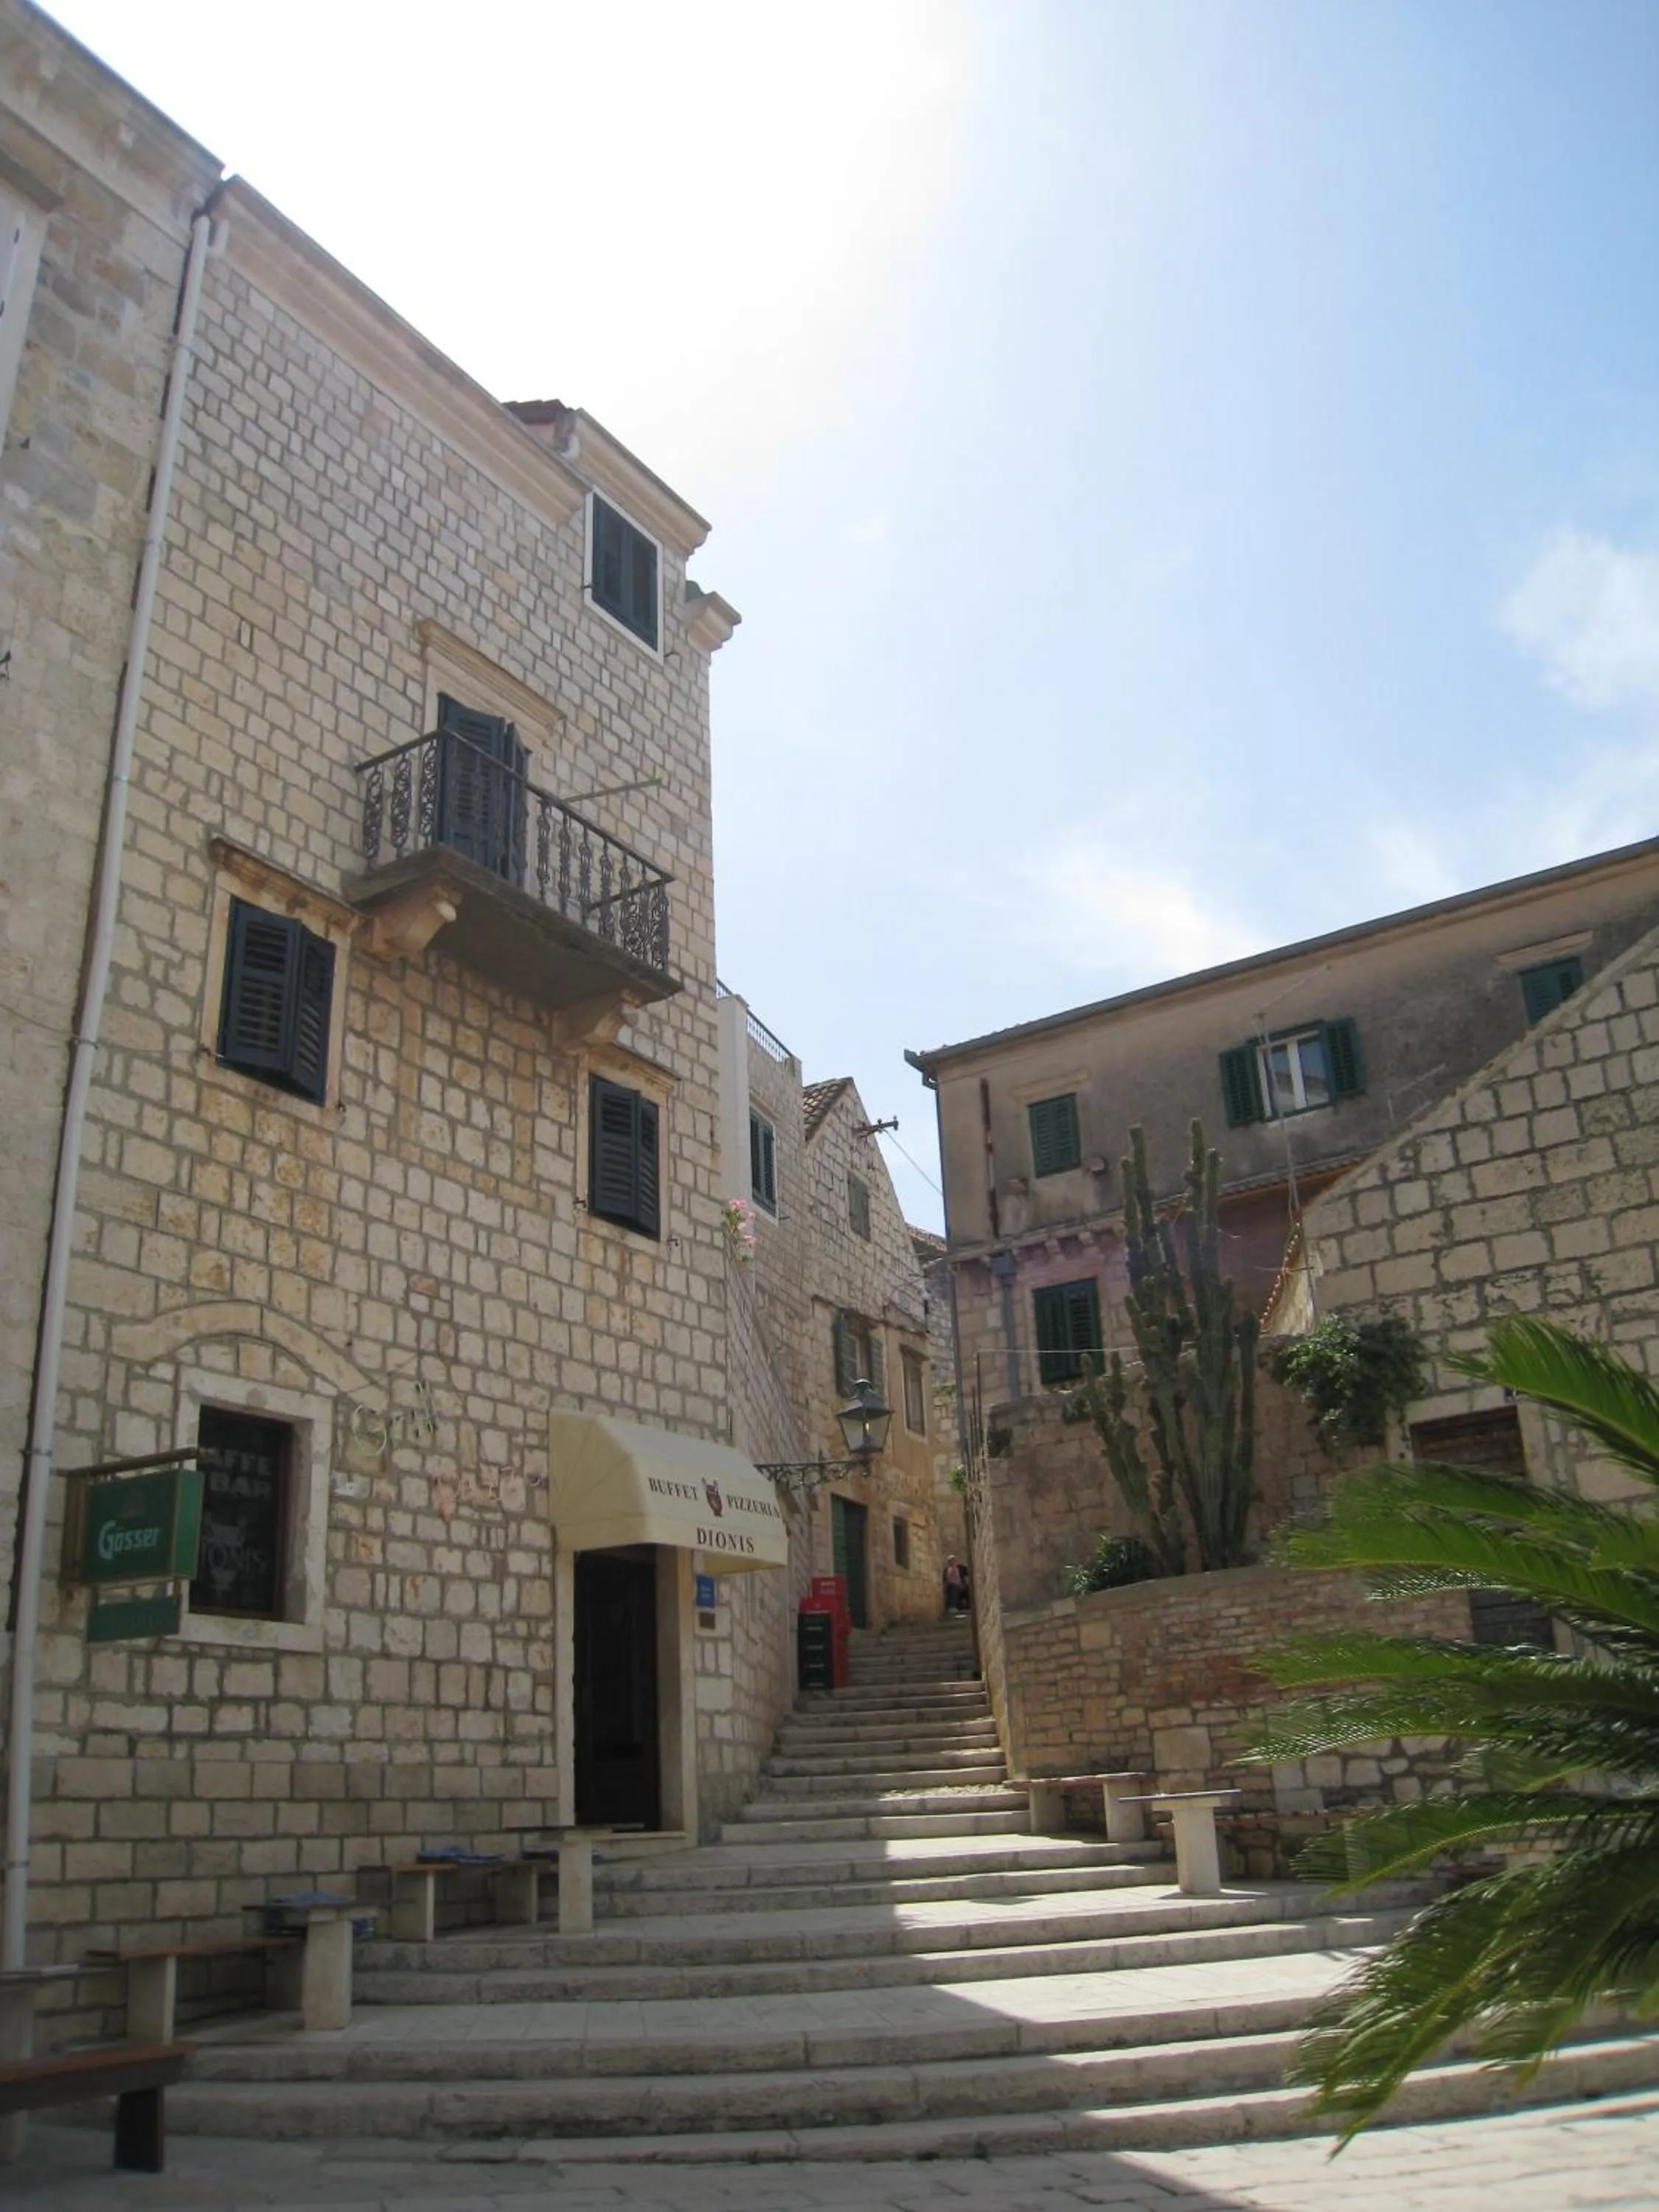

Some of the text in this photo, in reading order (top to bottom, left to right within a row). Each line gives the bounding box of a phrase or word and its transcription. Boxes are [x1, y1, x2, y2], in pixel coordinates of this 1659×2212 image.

[209, 1472, 271, 1499] BAR
[648, 1477, 781, 1519] BUFFET PIZZERIA
[697, 1527, 755, 1553] DIONIS
